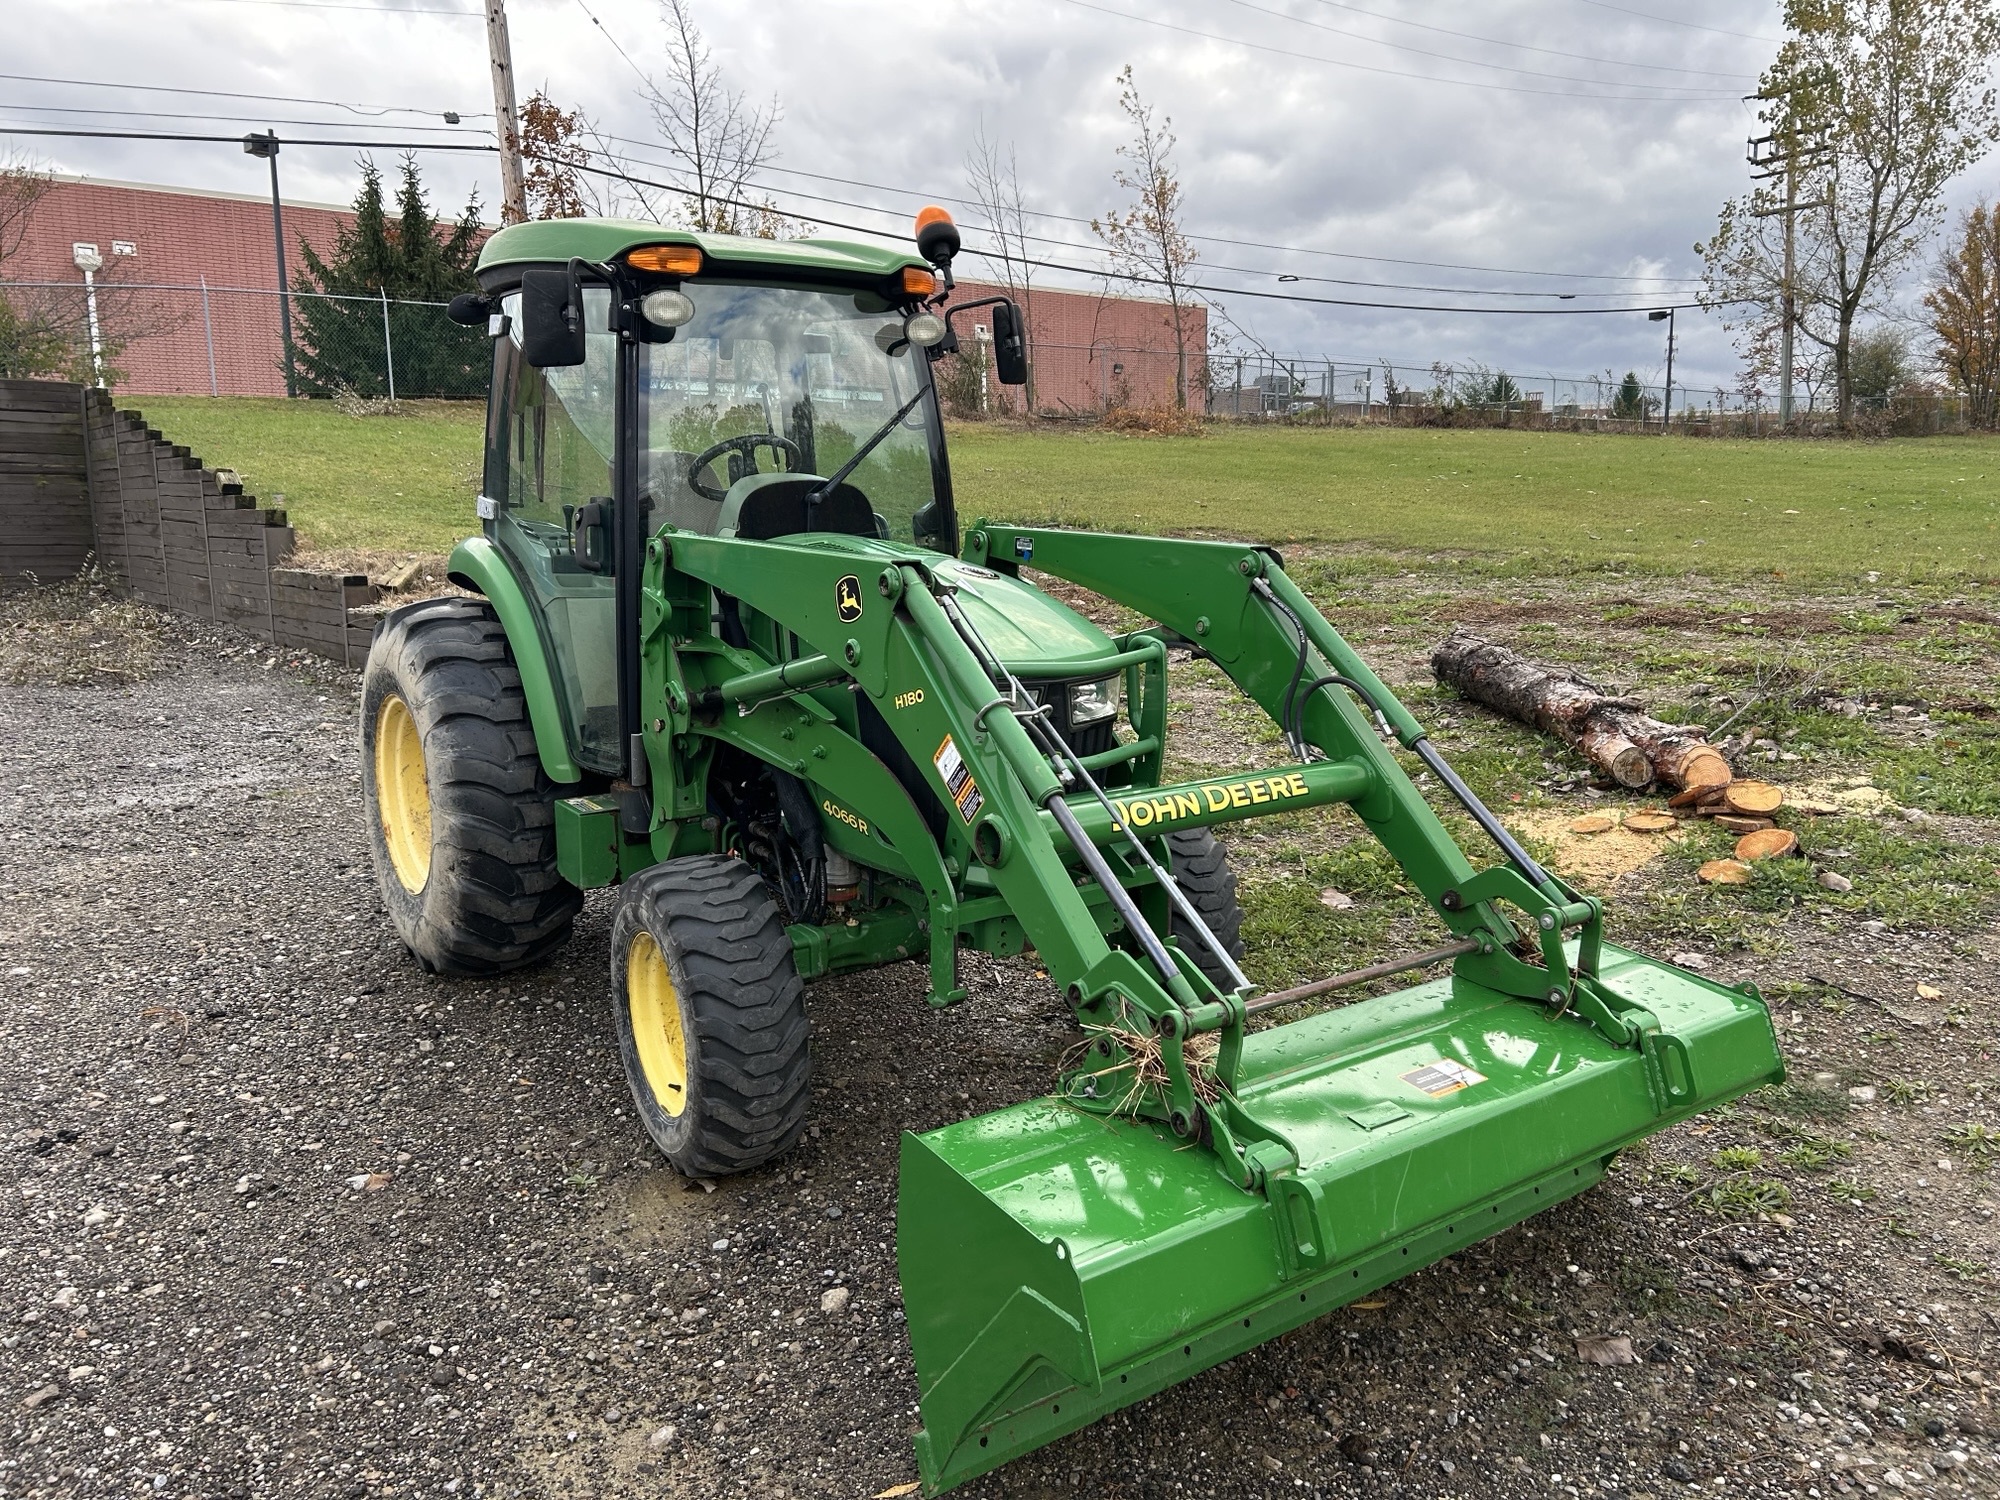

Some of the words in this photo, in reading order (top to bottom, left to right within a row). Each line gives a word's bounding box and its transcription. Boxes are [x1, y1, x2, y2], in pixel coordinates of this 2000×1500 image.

[895, 689, 925, 710] H180
[823, 800, 869, 836] 4066R
[1112, 792, 1200, 832] JOHN
[1201, 773, 1309, 812] DEERE
